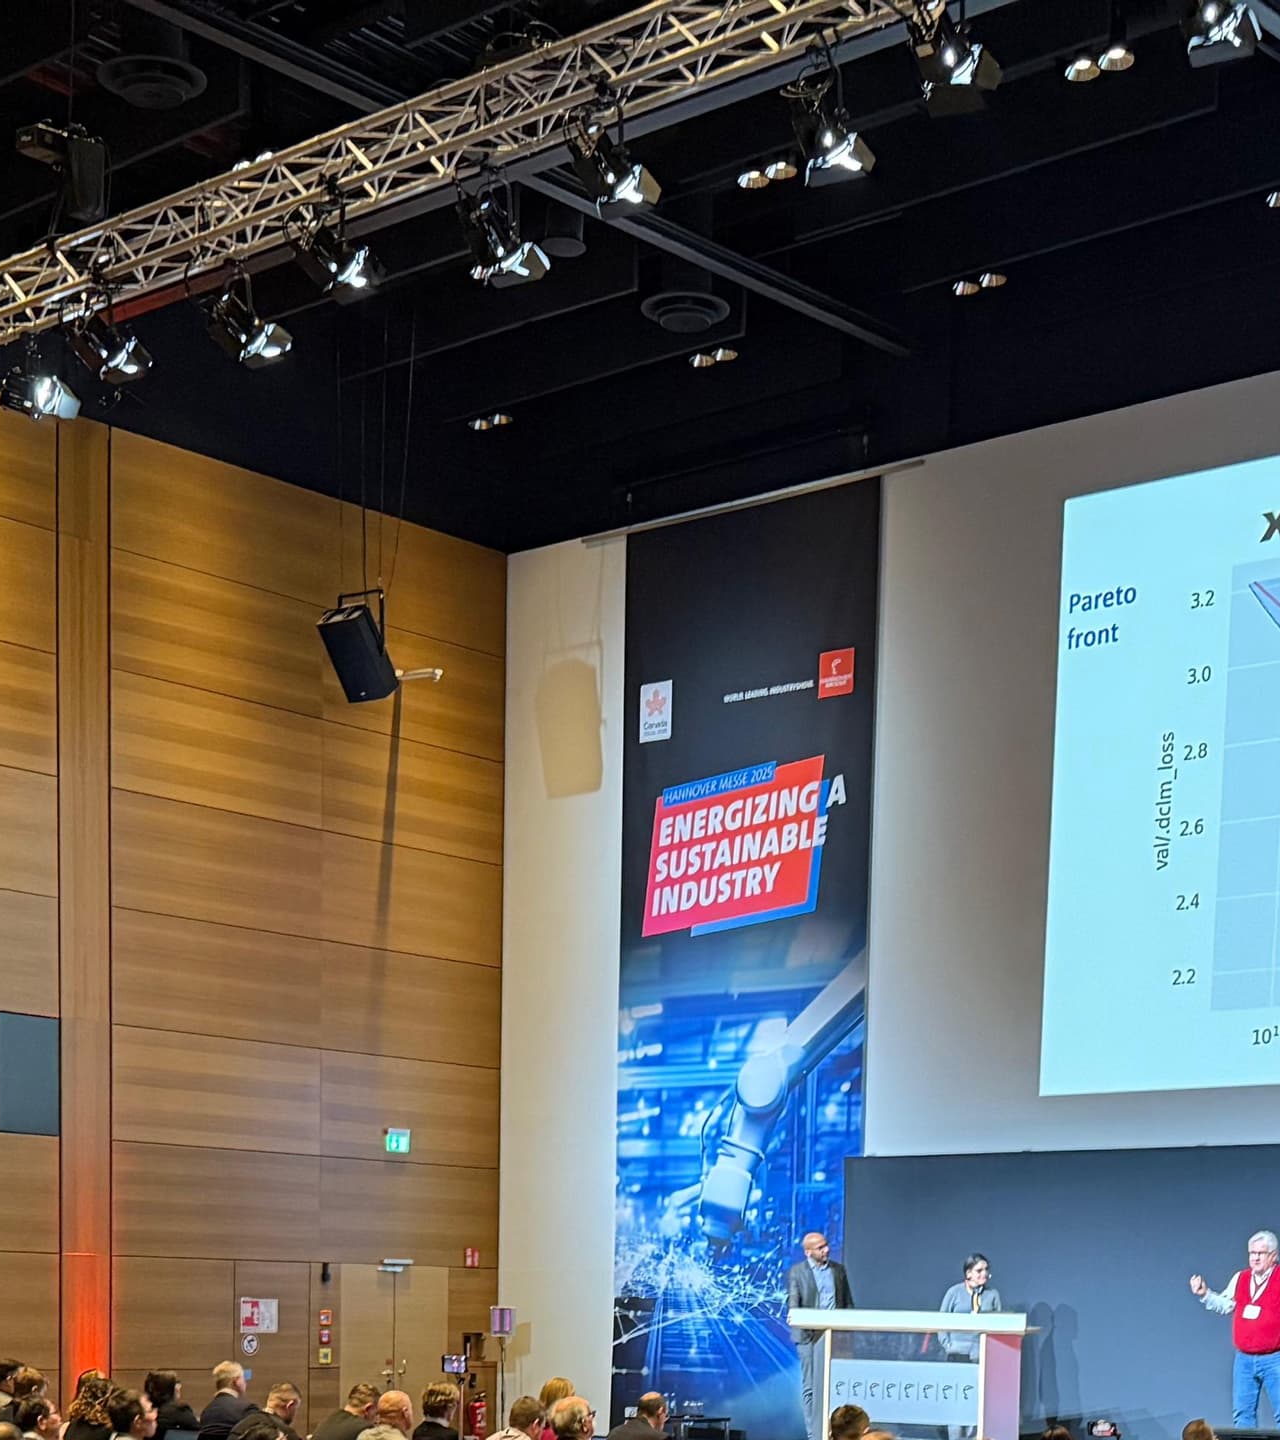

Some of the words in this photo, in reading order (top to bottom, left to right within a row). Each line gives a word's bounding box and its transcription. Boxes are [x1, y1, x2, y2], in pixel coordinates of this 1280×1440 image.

[1069, 585, 1137, 614] Pareto
[1190, 590, 1215, 609] 3.2
[1067, 623, 1119, 650] front
[1187, 666, 1212, 684] 3.0
[1183, 743, 1208, 761] 2.8
[665, 779, 717, 802] HANNOVER
[720, 771, 748, 791] MESSE
[751, 765, 773, 784] 2025
[658, 781, 819, 847] ENERGIZING
[826, 774, 847, 808] A
[1179, 818, 1204, 837] 2.6
[655, 815, 828, 883] SUSTAINABLE
[651, 861, 781, 917] INDUSTRY
[1176, 893, 1200, 911] 2.4
[1172, 968, 1196, 985] 2.2
